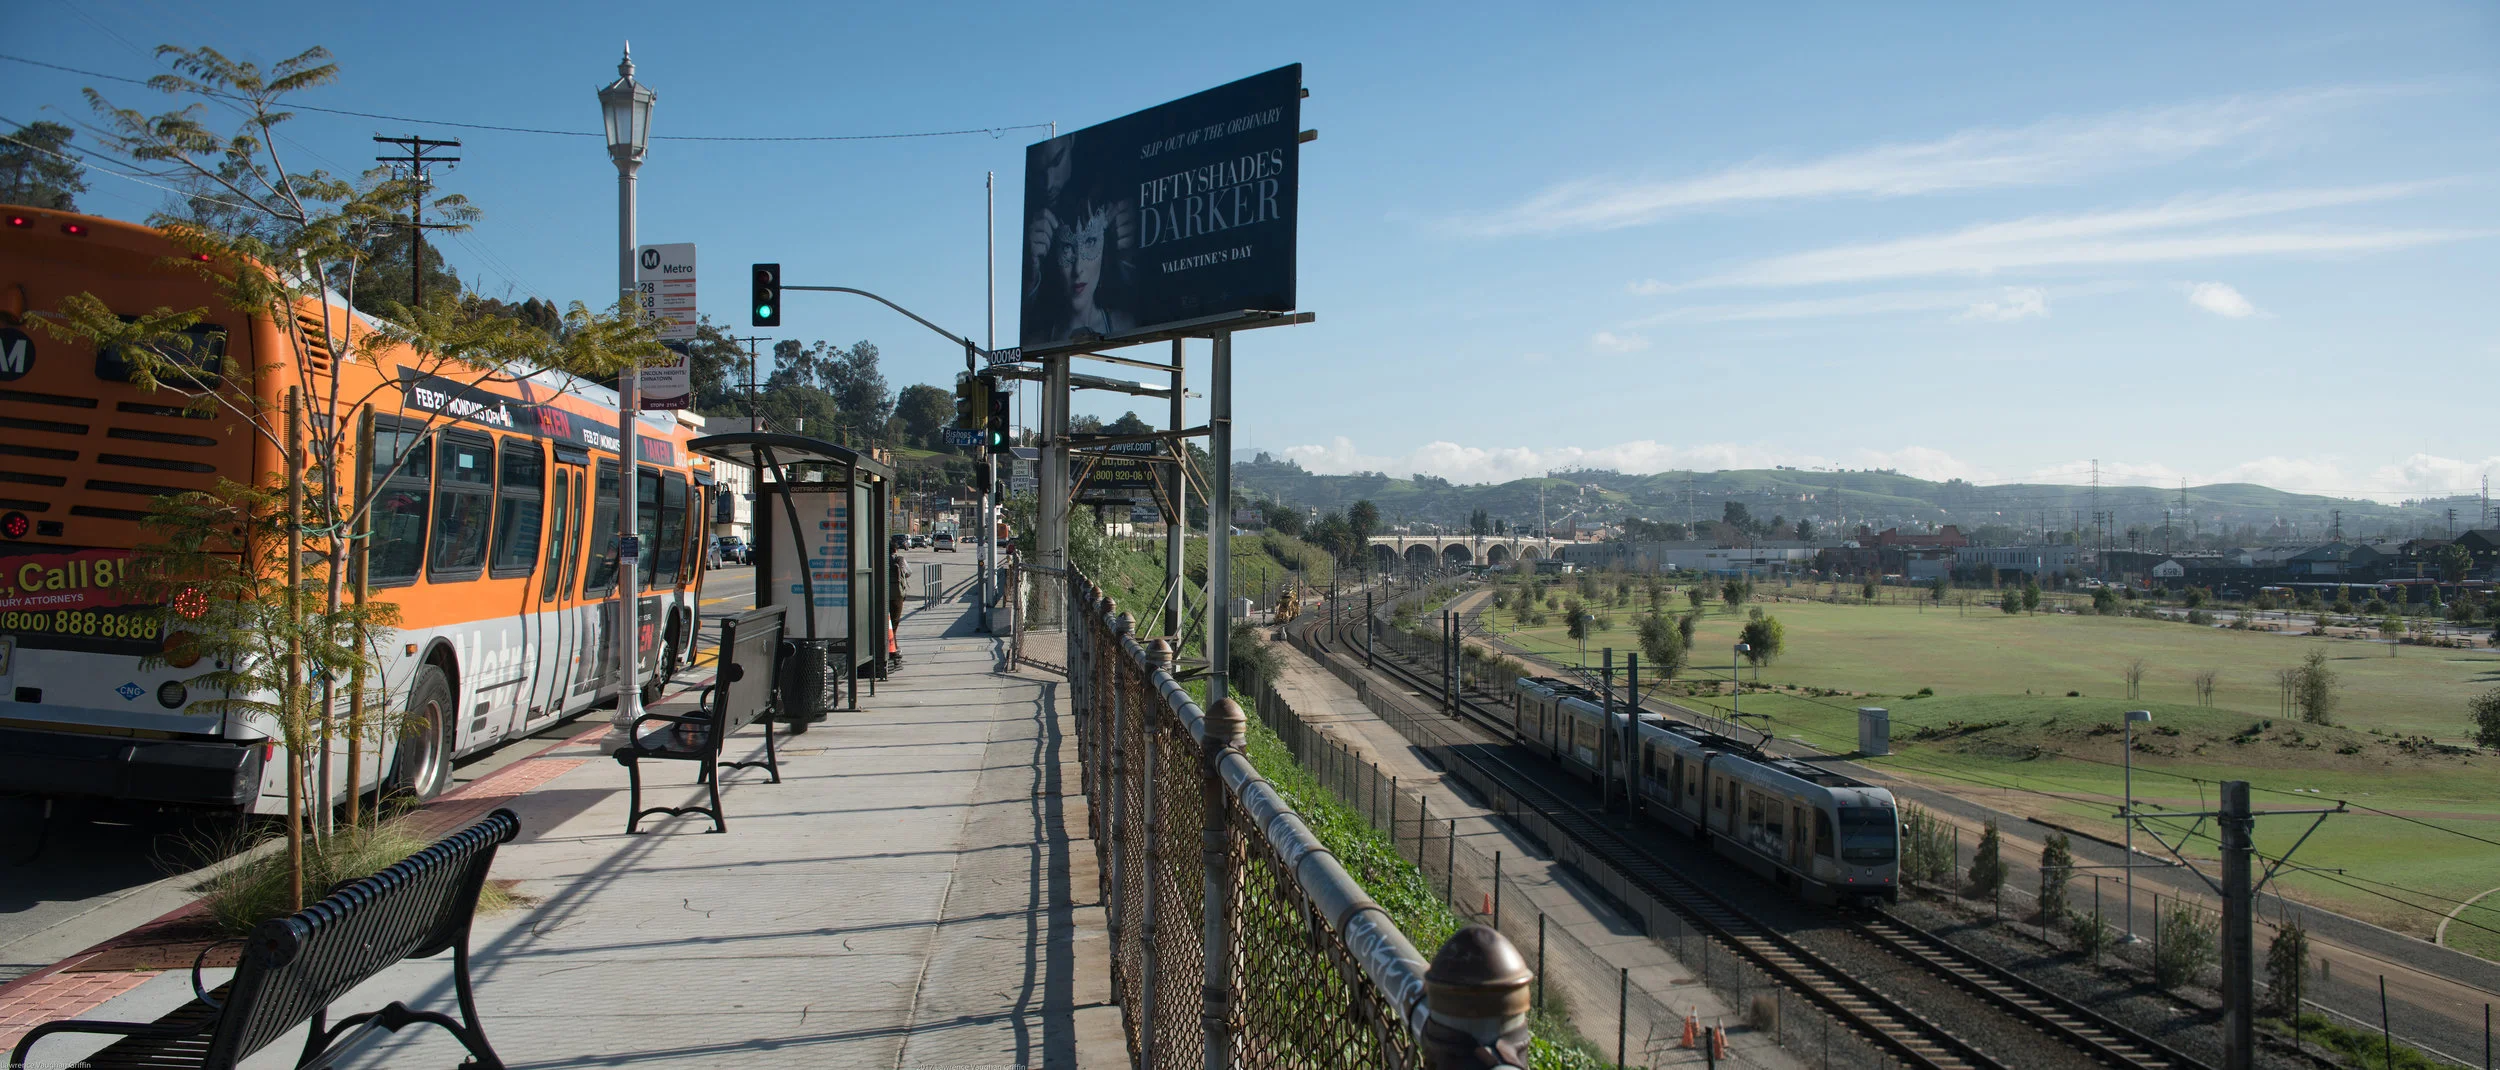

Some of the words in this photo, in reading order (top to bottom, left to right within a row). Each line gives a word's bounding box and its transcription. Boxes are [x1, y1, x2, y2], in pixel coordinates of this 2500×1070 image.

[1140, 141, 1163, 159] SLIP
[1165, 133, 1186, 152] OUT
[1187, 129, 1202, 146] OF
[1204, 122, 1225, 141] THE
[1227, 106, 1283, 135] ORDINARY
[1139, 178, 1281, 248] DARKER
[644, 252, 658, 267] M
[663, 264, 693, 274] Metro
[1162, 250, 1228, 274] VALENTINE'S
[1231, 245, 1253, 261] DAY
[641, 283, 655, 293] 28
[990, 348, 1021, 365] 000149
[415, 387, 434, 409] FEB
[433, 391, 445, 410] 27
[18, 559, 88, 592] Call
[24, 594, 84, 606] ATTORNEYS
[1, 611, 51, 632] (800)
[54, 610, 158, 640] 888-8888
[455, 629, 536, 720] Metro
[119, 686, 142, 696] CNG
